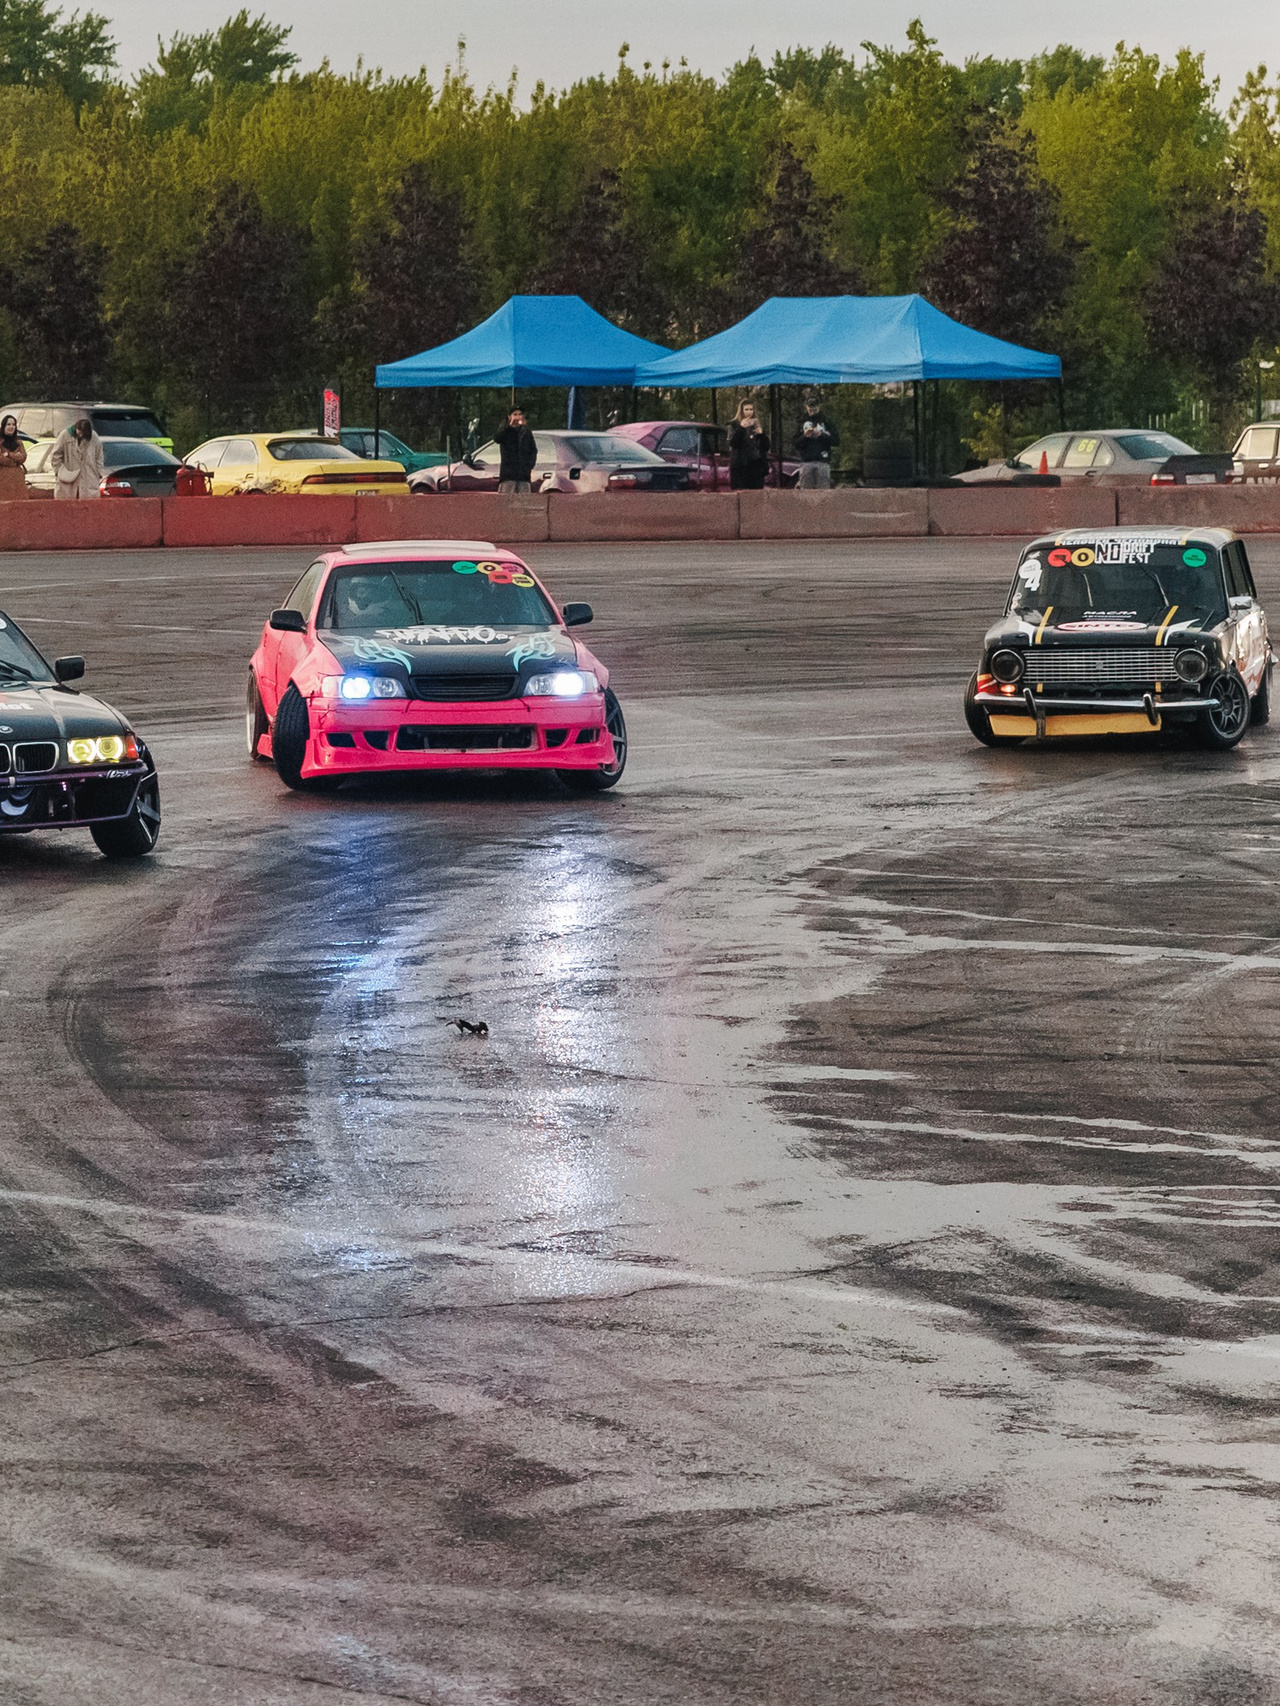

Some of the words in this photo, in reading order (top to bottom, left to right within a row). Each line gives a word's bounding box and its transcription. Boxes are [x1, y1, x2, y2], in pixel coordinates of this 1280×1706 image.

[1078, 439, 1096, 453] 66
[1123, 543, 1155, 553] DRIFT
[1123, 553, 1151, 564] FEST
[1024, 569, 1042, 591] 4
